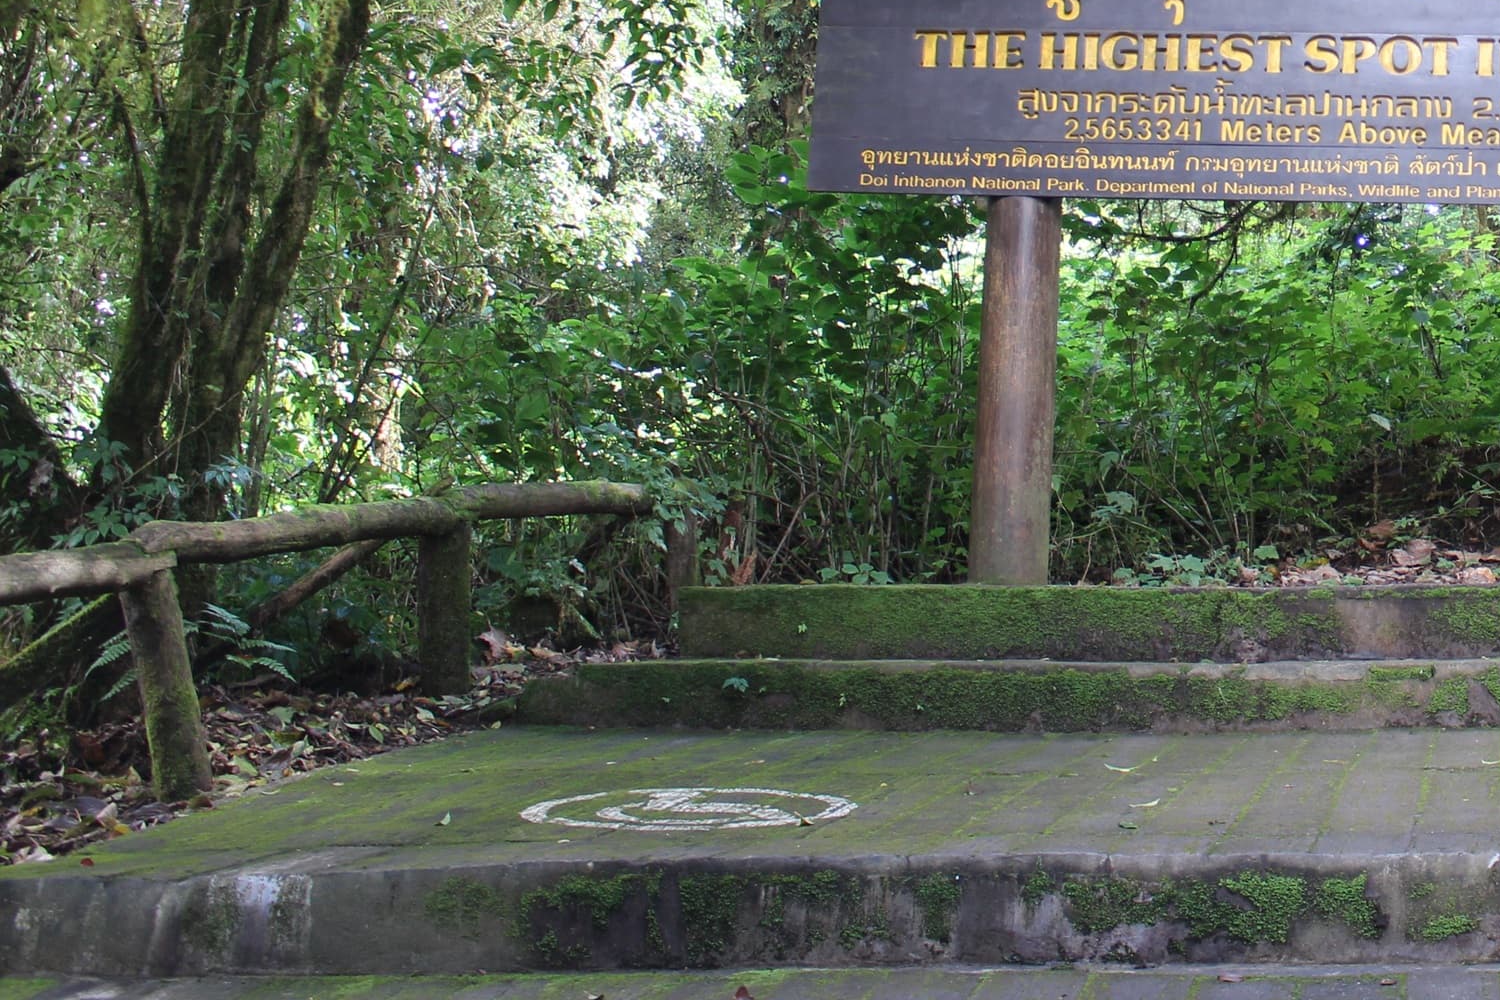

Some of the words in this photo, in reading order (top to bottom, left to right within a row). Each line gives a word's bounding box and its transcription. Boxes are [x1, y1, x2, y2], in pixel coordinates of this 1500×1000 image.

[914, 30, 1026, 69] THE
[1039, 30, 1292, 73] HIGHEST
[1304, 34, 1458, 76] SPOT
[1016, 77, 1452, 120] สูงจากระดับน้ำทะเลปานกลาง
[1220, 118, 1321, 144] Meters
[1338, 122, 1427, 147] Above
[860, 146, 1178, 170] อุทยานแห่งชาติดอยอินทนนท์
[1185, 155, 1400, 179] กรมอุทยานแห่งชาติ
[1409, 152, 1487, 177] สัตว์ป่า
[859, 174, 888, 188] Doi
[894, 175, 966, 190] Inthanon
[972, 177, 1041, 191] National
[1096, 179, 1195, 195] Department
[1202, 181, 1218, 193] of
[1224, 182, 1294, 195] National
[1358, 185, 1420, 198] Wildlife
[1427, 186, 1460, 198] and
